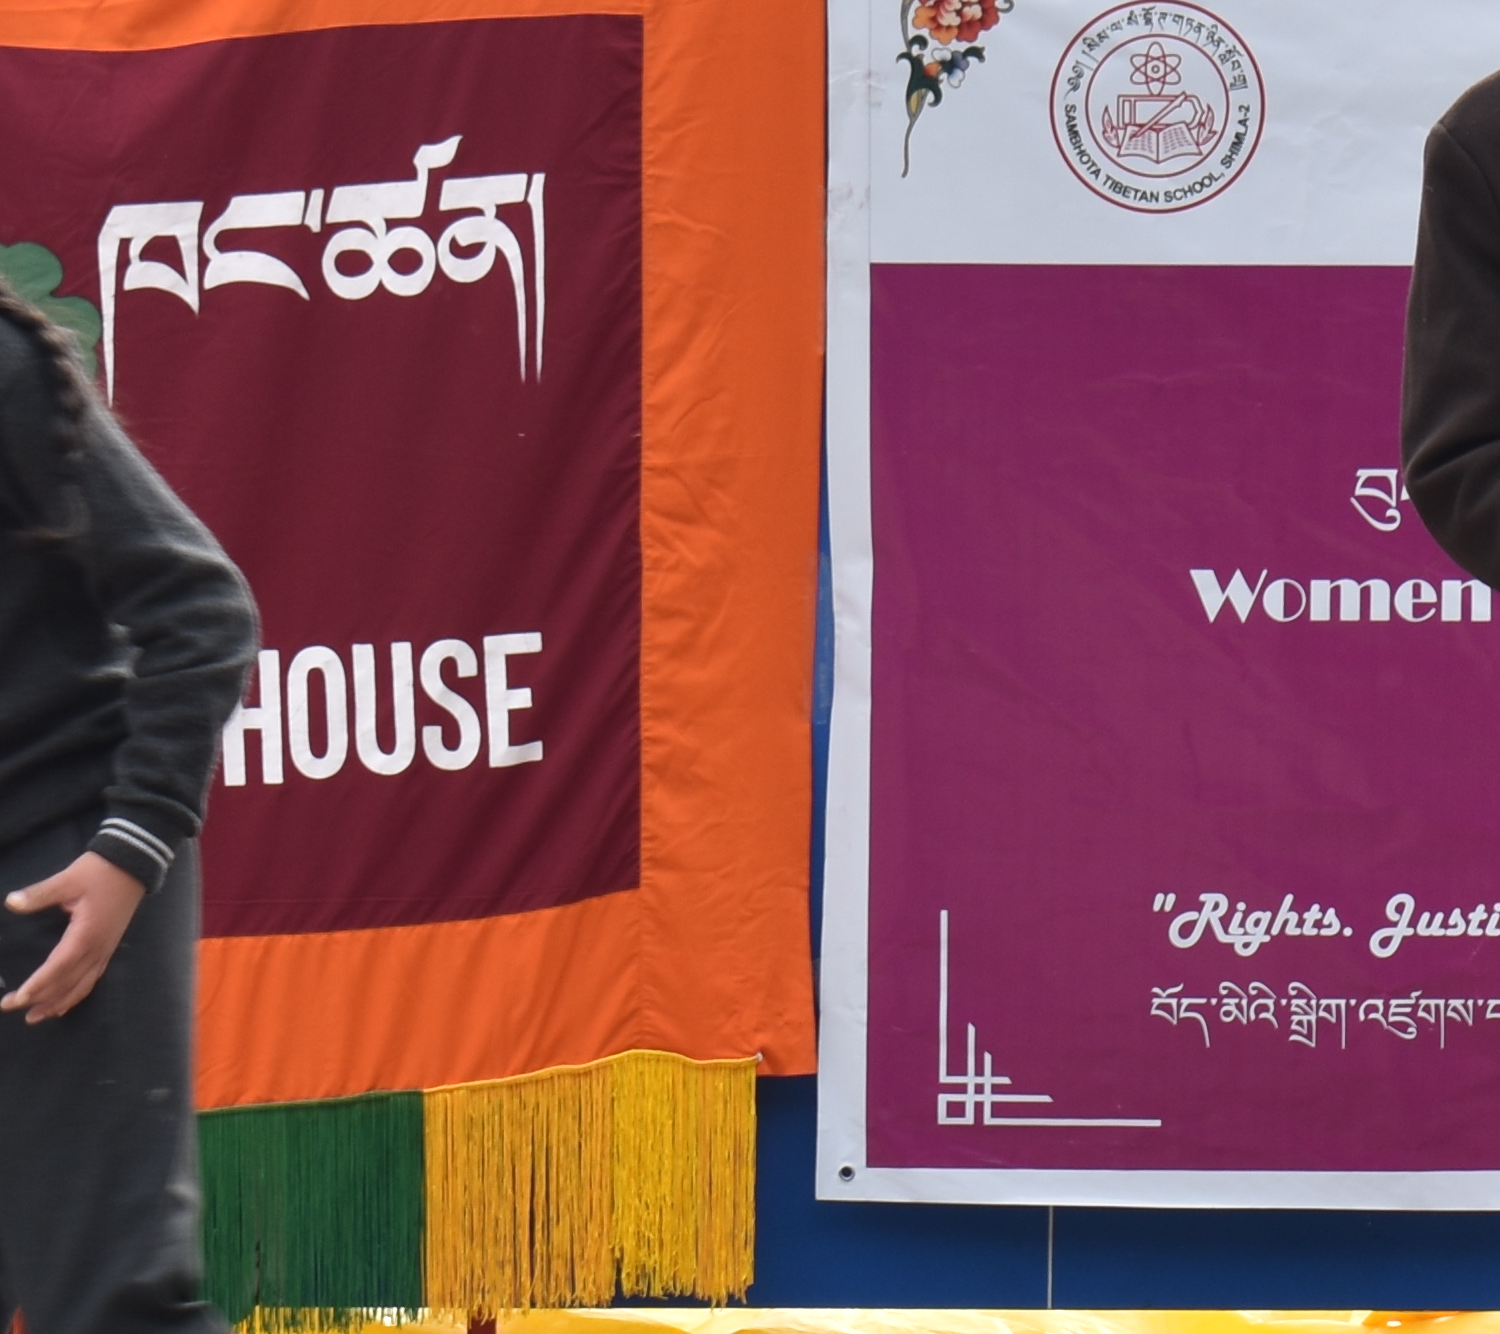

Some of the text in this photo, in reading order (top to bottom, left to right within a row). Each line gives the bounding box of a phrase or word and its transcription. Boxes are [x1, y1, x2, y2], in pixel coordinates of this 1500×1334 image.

[1064, 103, 1251, 203] SAMBHOTA TIBETAN SCHOOL, SHIMLA-2
[222, 631, 544, 787] HOUSE
